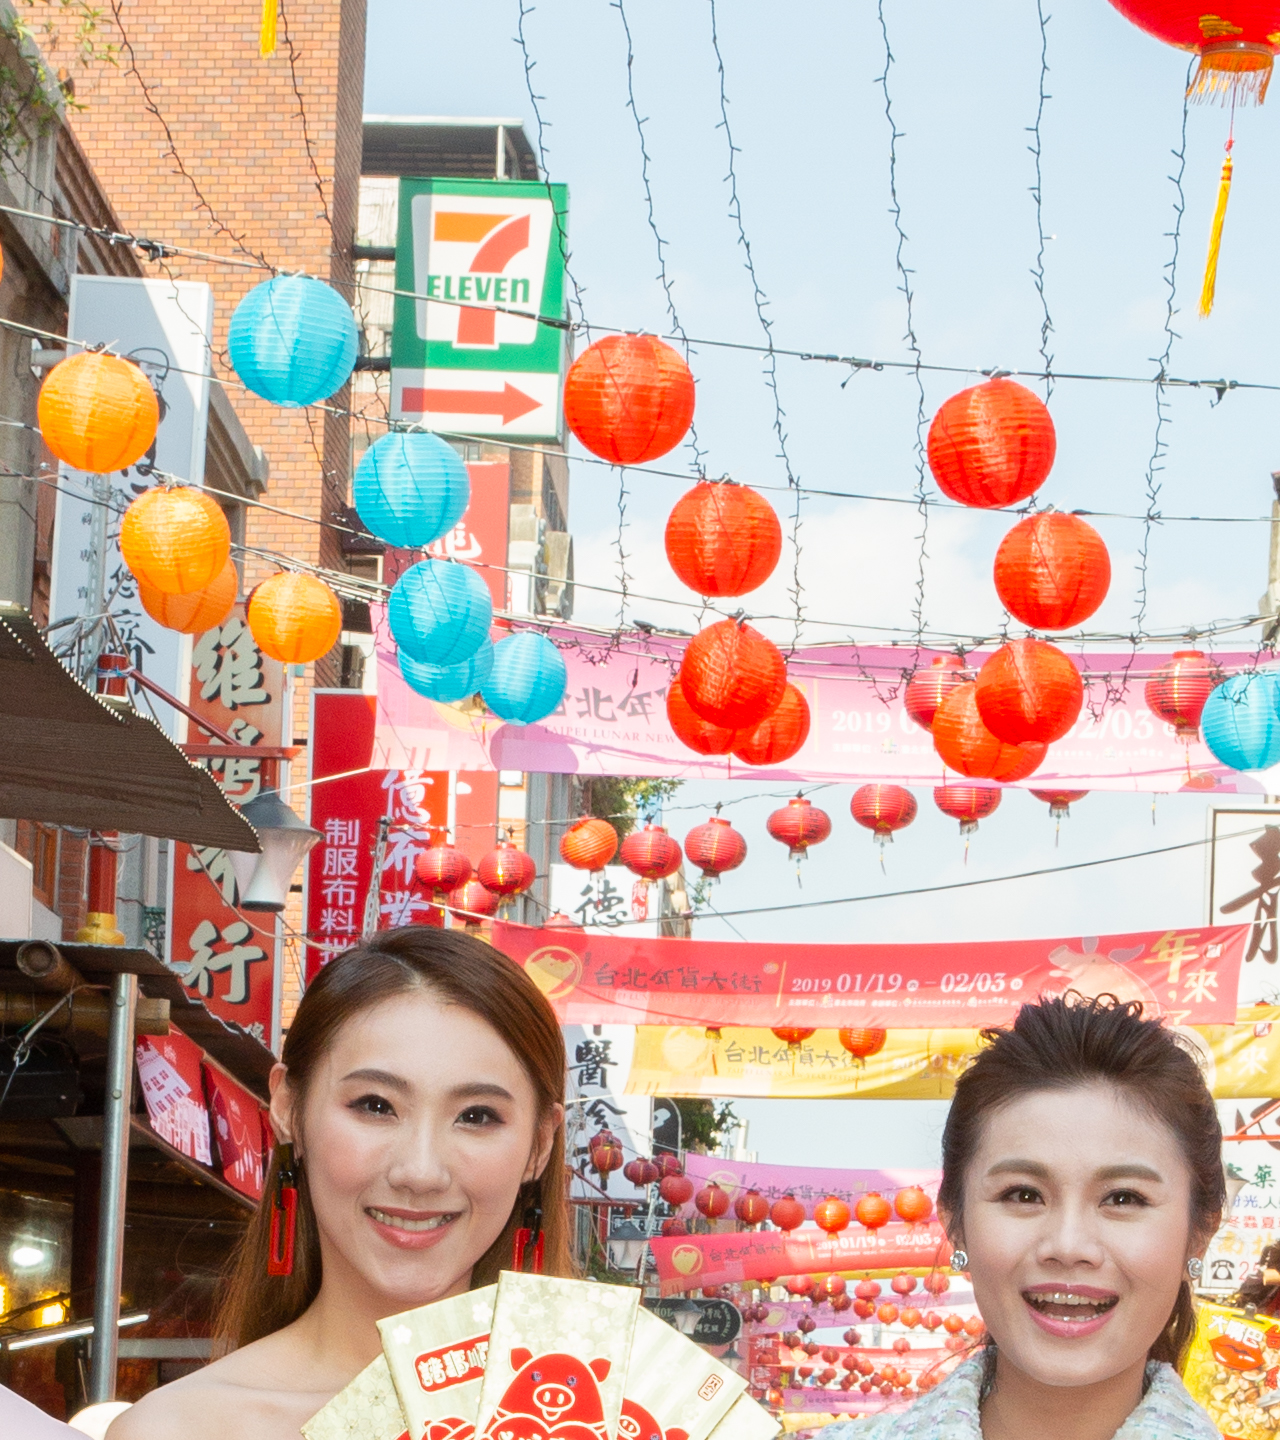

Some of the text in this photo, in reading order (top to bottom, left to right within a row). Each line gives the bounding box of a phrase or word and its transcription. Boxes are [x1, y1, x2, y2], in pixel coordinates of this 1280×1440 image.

[593, 727, 640, 741] LUNAR
[646, 733, 676, 745] NEW
[831, 709, 1154, 742] 2019 2/03
[574, 879, 628, 927] 德
[594, 962, 762, 993] 台北年貨大街
[791, 978, 831, 992] 2019
[837, 973, 902, 993] 01/19
[940, 972, 1007, 993] 02/03
[1208, 1315, 1264, 1348] 大嘴巴
